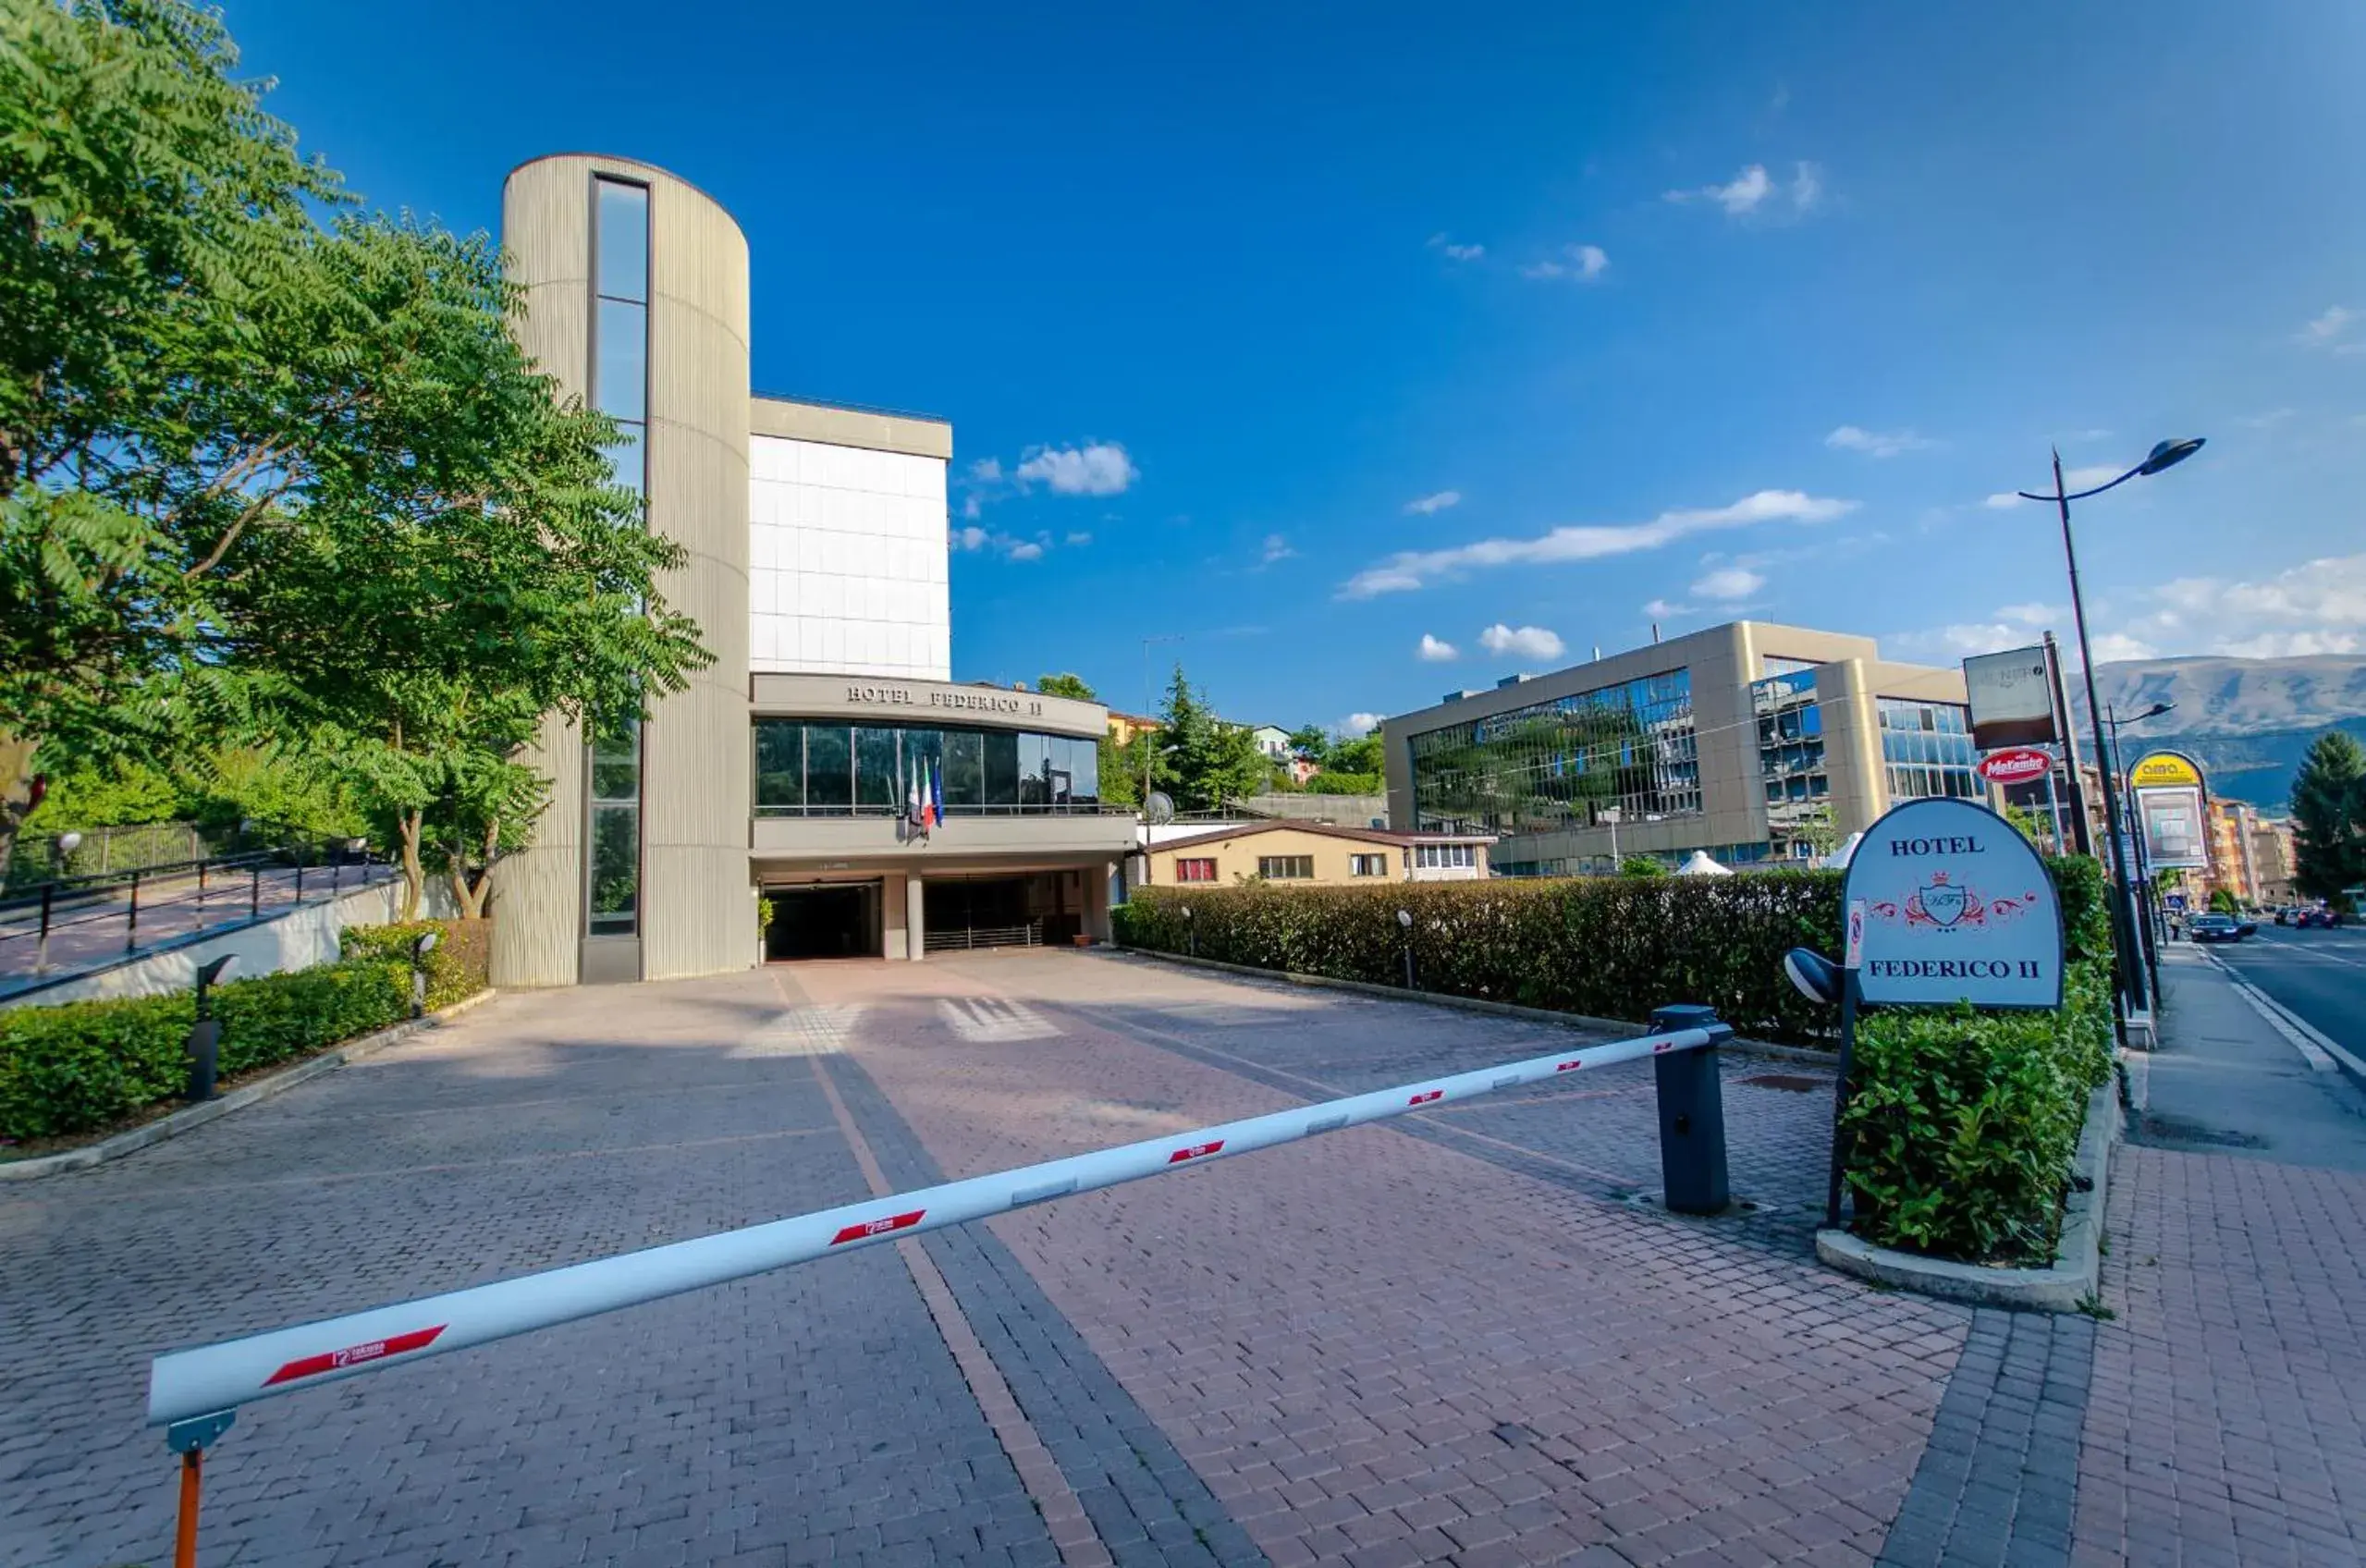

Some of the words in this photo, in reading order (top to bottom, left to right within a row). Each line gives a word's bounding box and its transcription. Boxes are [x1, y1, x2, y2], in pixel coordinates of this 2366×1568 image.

[847, 687, 913, 704] HOTEL
[931, 692, 1019, 712] FEDERICO
[1030, 702, 1043, 716] II
[1891, 836, 1985, 856] HOTEL
[1870, 960, 2010, 978] FEDERICO
[2019, 961, 2041, 979] II
